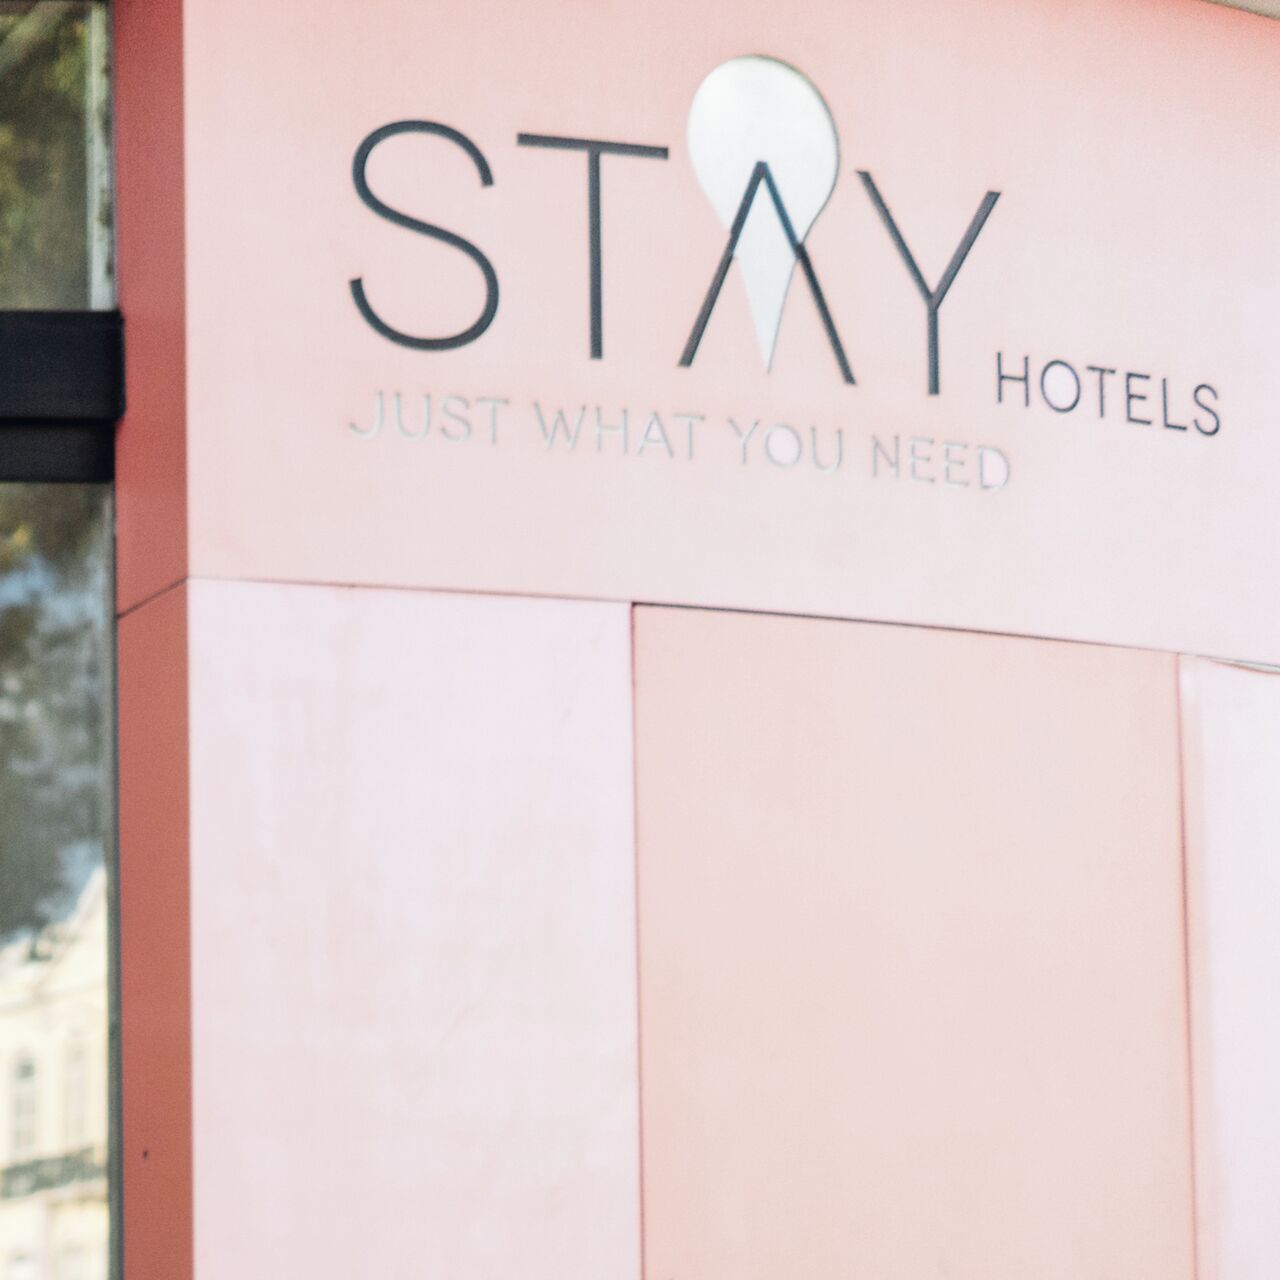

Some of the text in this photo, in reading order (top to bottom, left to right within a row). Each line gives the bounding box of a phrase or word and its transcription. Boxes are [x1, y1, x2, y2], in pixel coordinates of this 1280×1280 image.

[349, 118, 1002, 396] STAY
[348, 390, 1011, 492] JUST WHAT YOU NEED
[995, 351, 1221, 437] HOTELS
